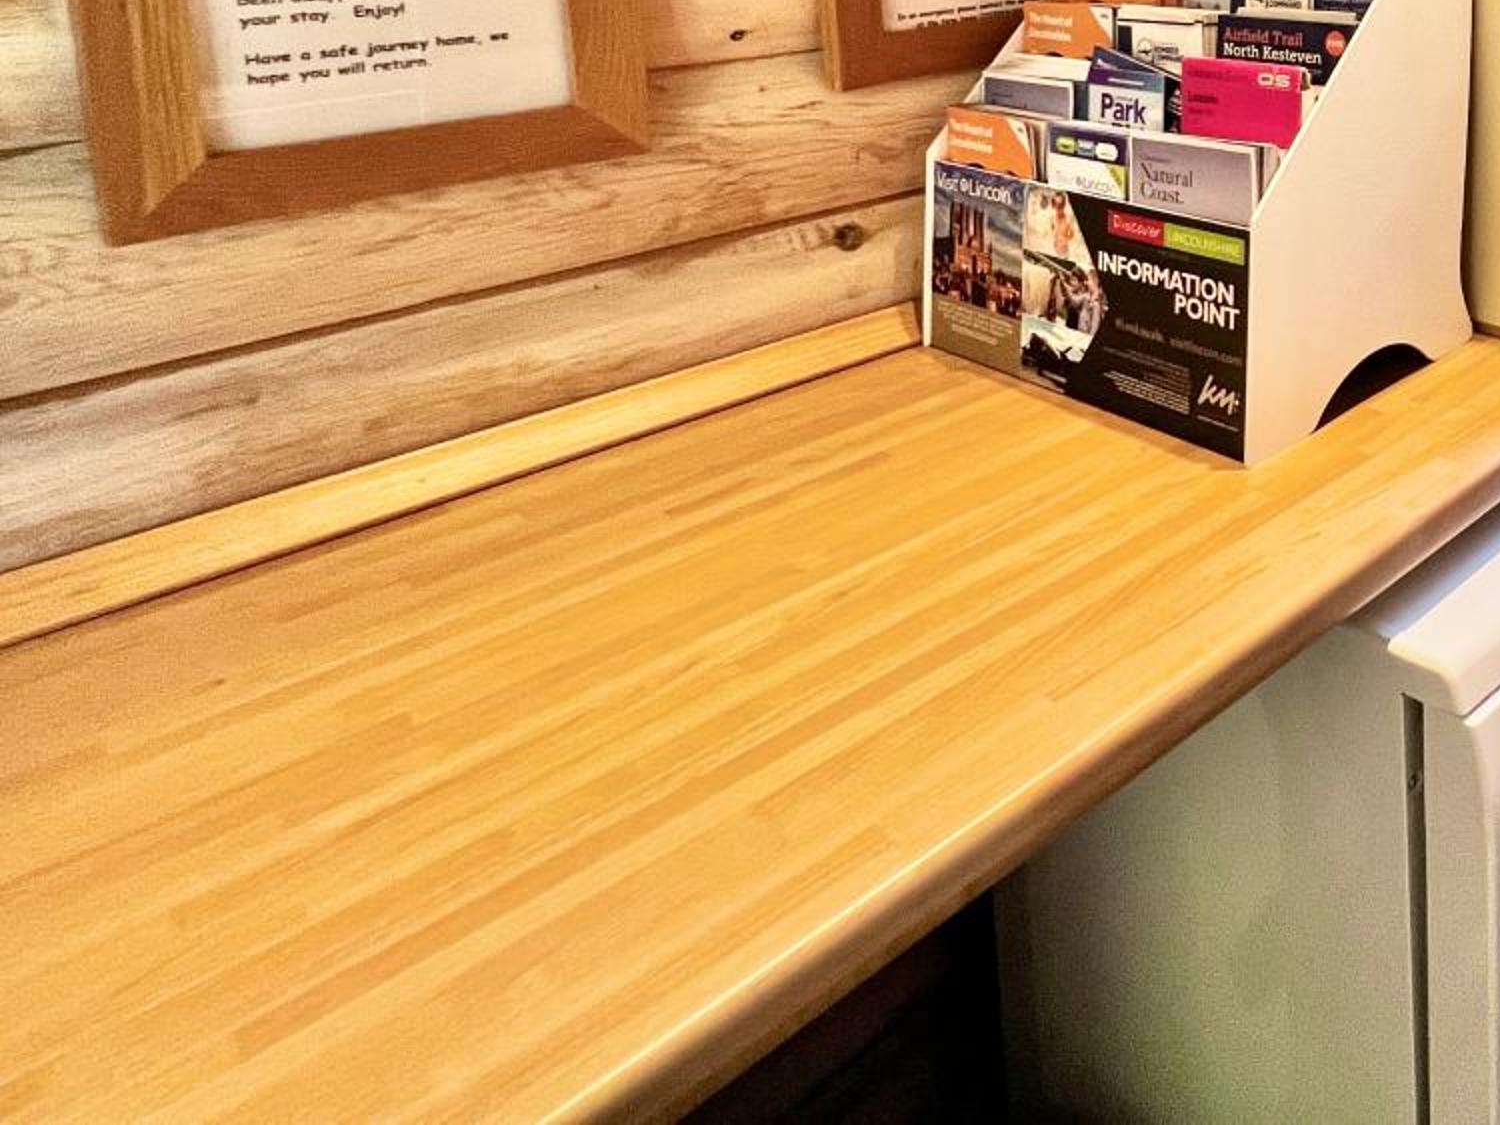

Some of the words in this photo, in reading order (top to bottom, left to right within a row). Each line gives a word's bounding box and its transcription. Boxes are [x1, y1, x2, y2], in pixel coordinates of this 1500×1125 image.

[239, 15, 281, 30] your
[290, 11, 336, 24] stay.
[354, 3, 405, 18] Enjoy!
[245, 52, 291, 65] Have
[301, 51, 310, 60] a
[319, 45, 358, 59] safe
[366, 40, 429, 57] journey
[435, 34, 482, 47] home,
[489, 32, 510, 41] we
[1223, 27, 1269, 44] Airfield
[1273, 30, 1303, 47] Trail
[1223, 42, 1259, 58] North
[1262, 46, 1322, 64] Kesteven
[247, 73, 290, 86] hope
[299, 69, 330, 83] you
[337, 62, 365, 75] will
[373, 58, 432, 73] return.
[1101, 93, 1147, 125] Park
[1140, 162, 1193, 188] Natural
[969, 179, 1011, 205] Lincoln
[1097, 251, 1237, 307] INFORMATION
[1174, 294, 1241, 331] POINT
